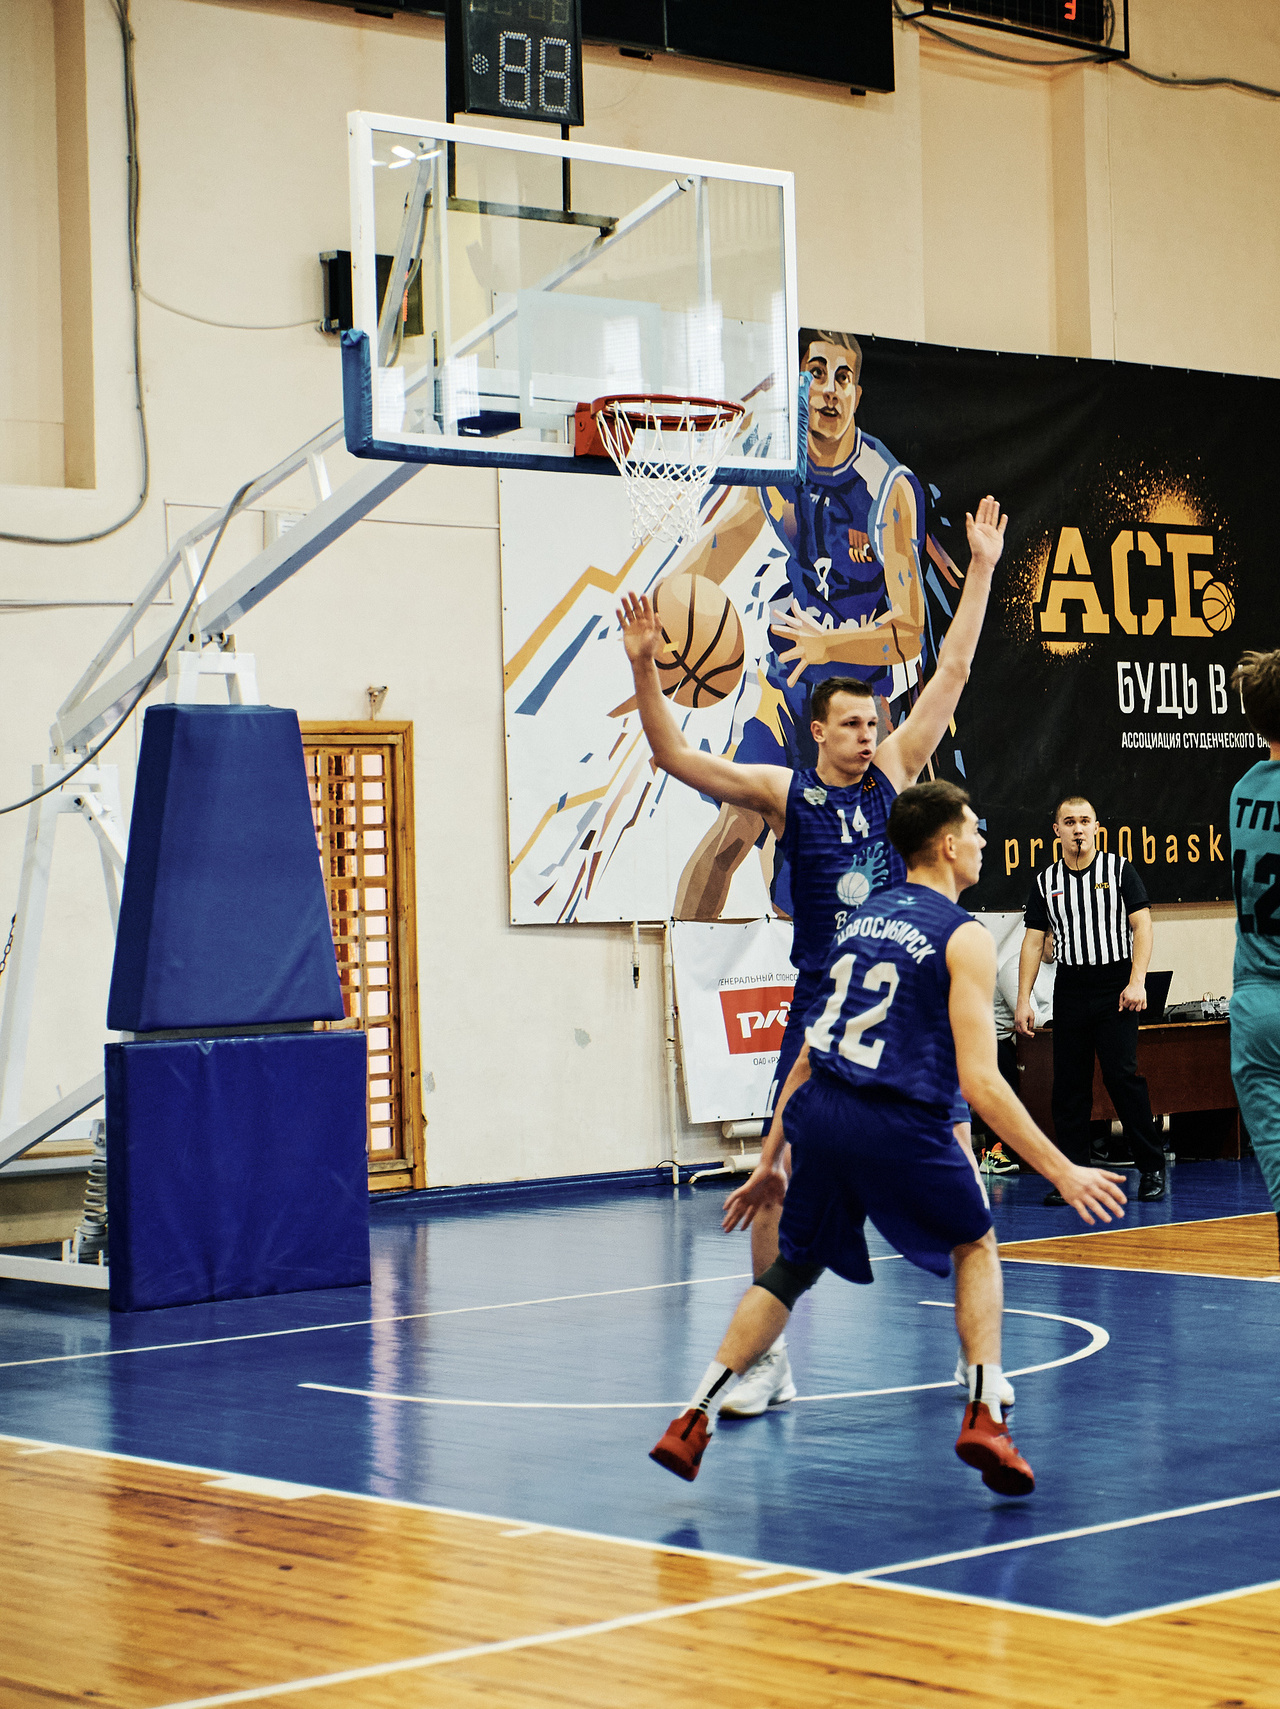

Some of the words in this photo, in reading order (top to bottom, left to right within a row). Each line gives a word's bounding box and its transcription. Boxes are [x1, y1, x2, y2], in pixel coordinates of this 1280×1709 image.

[1040, 526, 1235, 638] АСБ
[1117, 661, 1198, 719] БУДЬ
[1208, 663, 1228, 715] В
[1121, 731, 1181, 750] АССОЦИАЦИЯ
[1182, 732, 1255, 750] СТУДЕНЧЕСКОГО
[836, 805, 870, 843] 14
[1004, 824, 1225, 876] pr00bask
[718, 972, 774, 987] ГЕНЕРАЛЬНЫЙ
[804, 953, 900, 1070] 12
